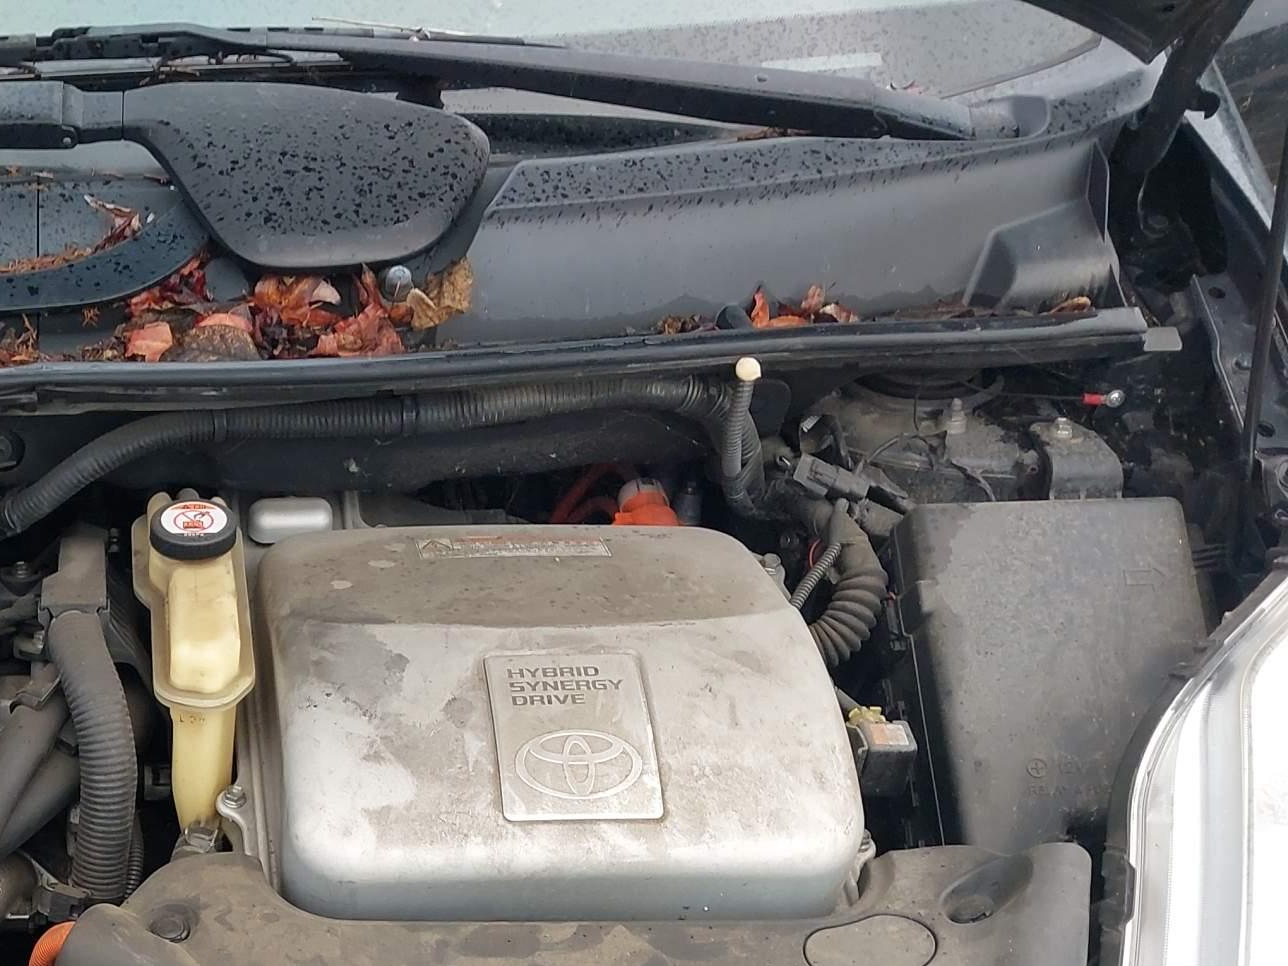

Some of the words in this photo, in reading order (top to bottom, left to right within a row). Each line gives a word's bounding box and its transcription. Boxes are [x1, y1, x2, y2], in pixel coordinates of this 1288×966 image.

[507, 666, 600, 679] HYBRID
[509, 679, 623, 692] SYNERGY
[512, 693, 586, 706] DRIVE
